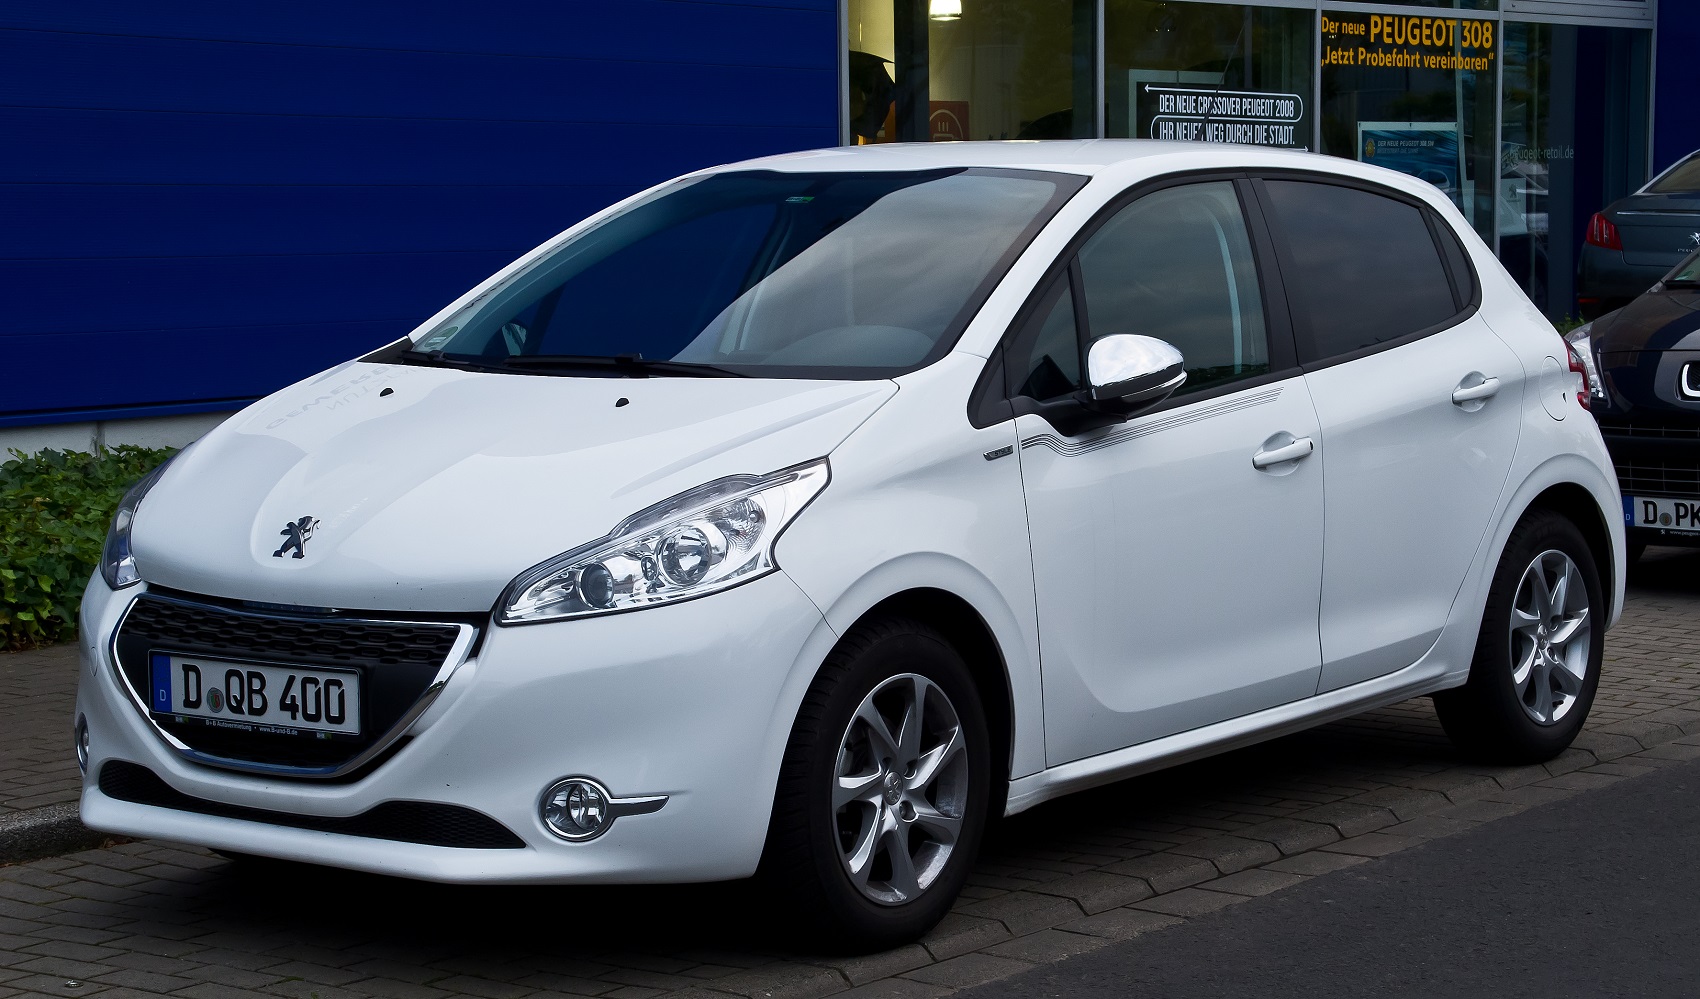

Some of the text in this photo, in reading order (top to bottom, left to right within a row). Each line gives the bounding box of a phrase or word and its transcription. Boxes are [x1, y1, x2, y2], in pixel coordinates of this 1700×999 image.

[1321, 15, 1493, 49] Der neue PEUGEOT 308
[1358, 46, 1421, 68] Probefahrt
[1159, 94, 1174, 113] DER
[1176, 95, 1196, 114] NEUE
[1242, 98, 1274, 117] PEUGEOT
[1275, 99, 1294, 118] 2008
[1159, 121, 1174, 140] IHR
[1205, 123, 1224, 143] WEG
[1226, 123, 1253, 144] DURCH
[1254, 124, 1268, 144] DIE
[1269, 125, 1295, 145] STADT.
[1625, 513, 1631, 521] D
[1643, 500, 1700, 527] D PK
[159, 689, 167, 702] D
[182, 663, 346, 725] D QB 400
